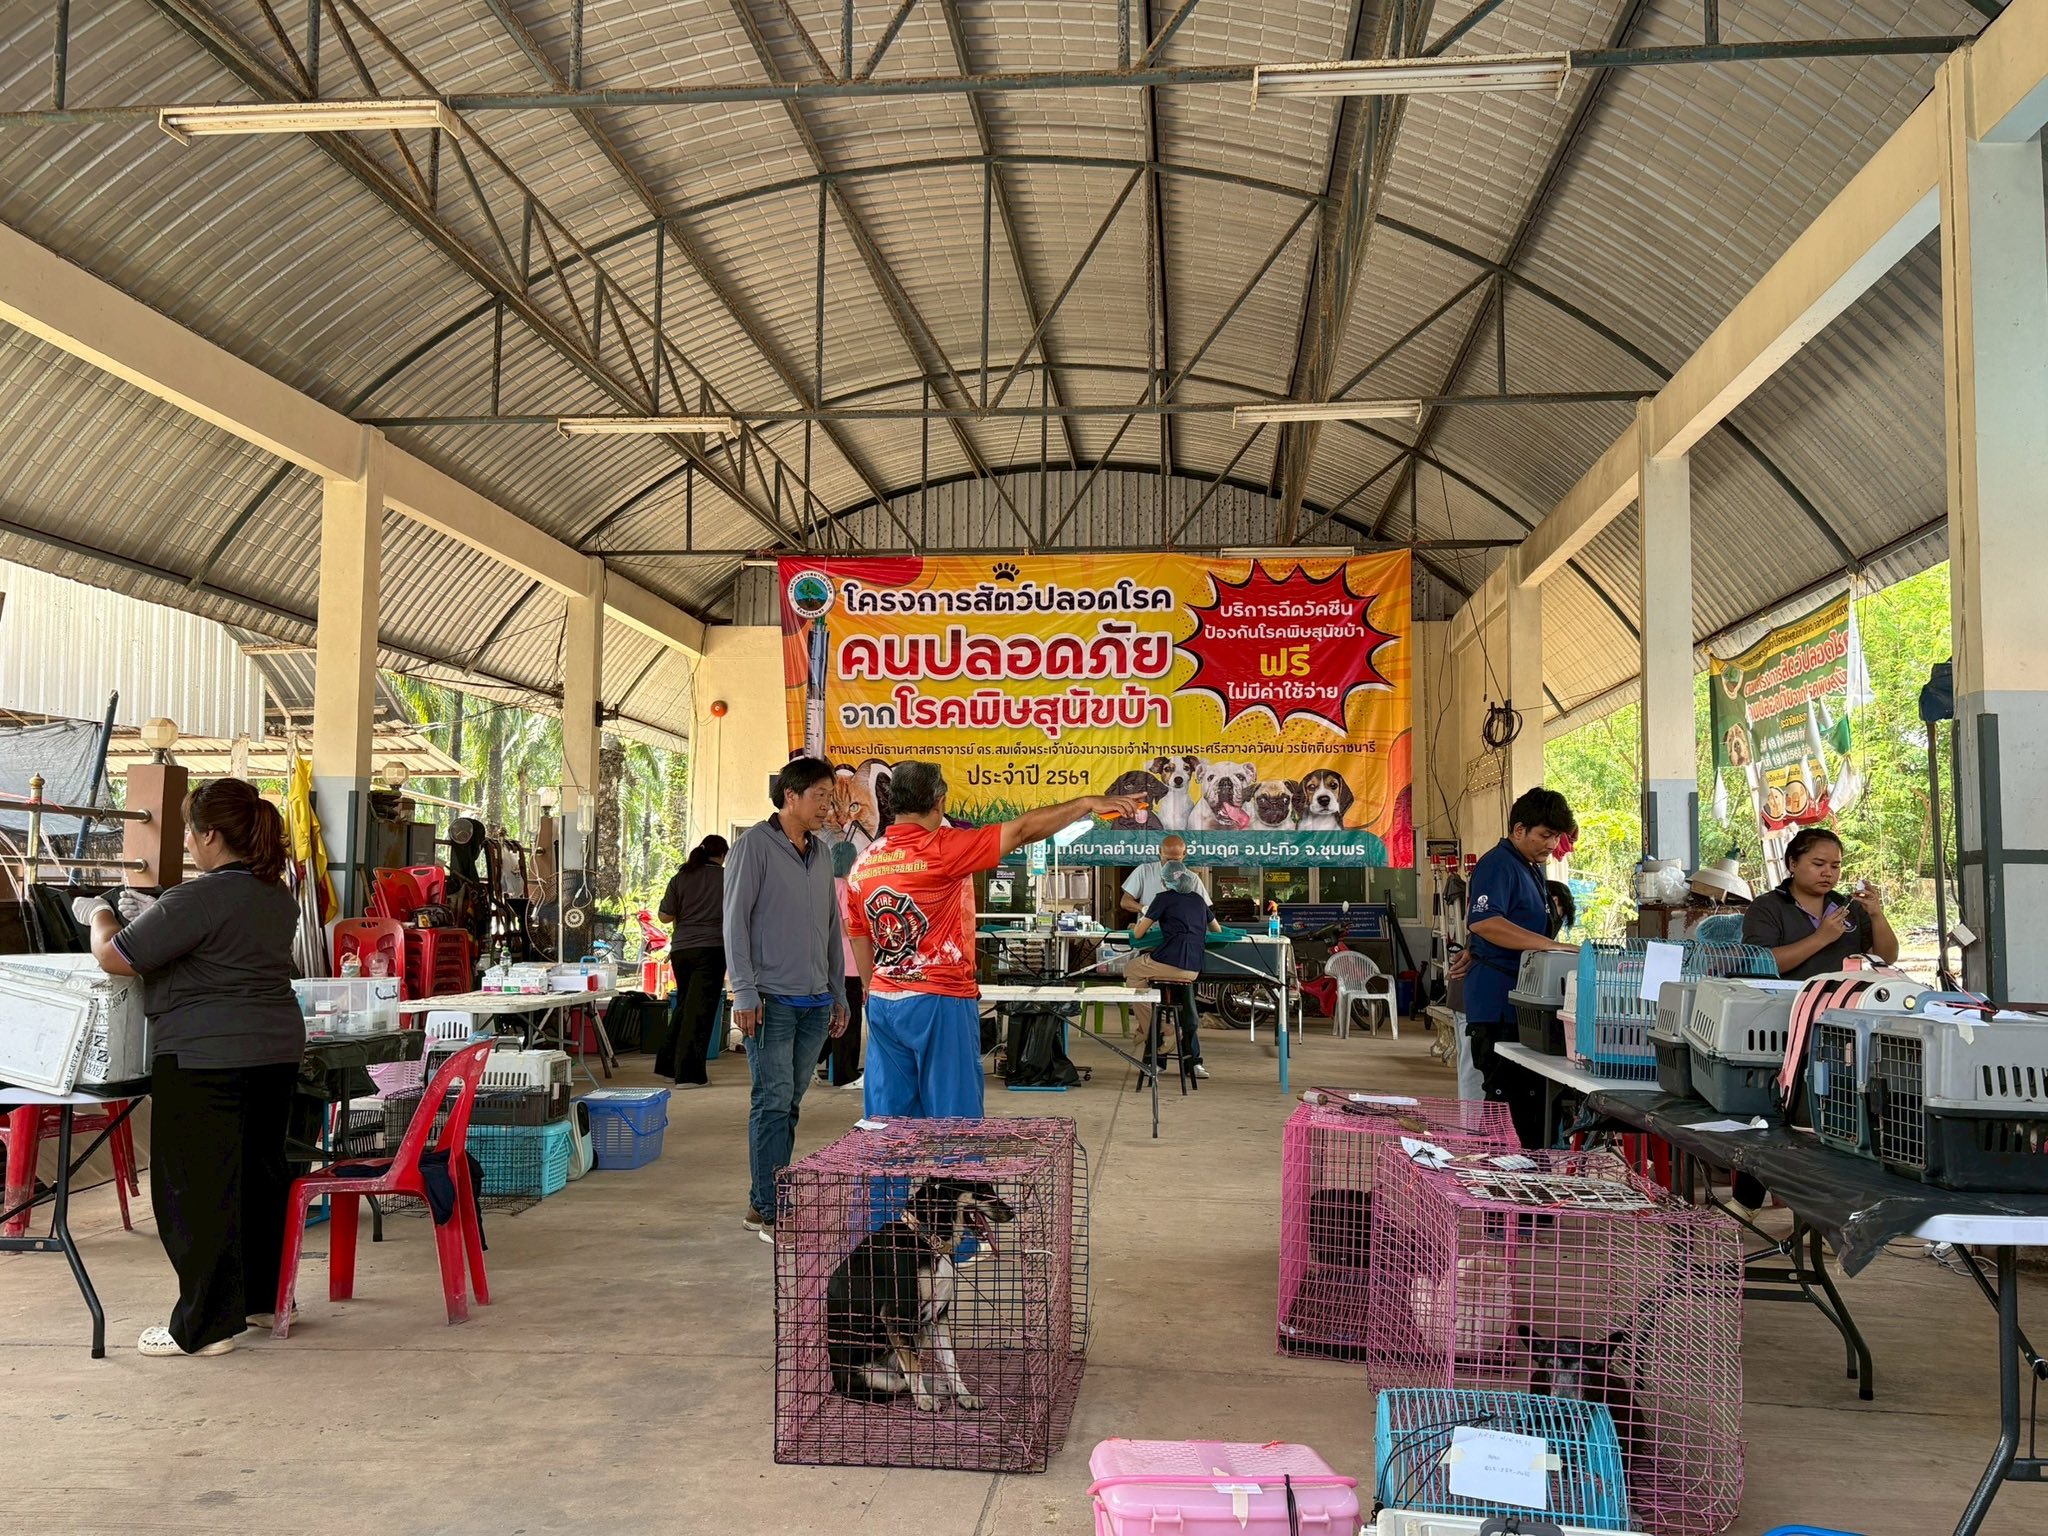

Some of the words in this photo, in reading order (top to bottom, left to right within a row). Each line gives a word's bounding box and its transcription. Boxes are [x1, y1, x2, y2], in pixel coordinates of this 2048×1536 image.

[844, 582, 1172, 612] โครงการสัตว์ปลอดโรค
[1220, 599, 1353, 618] บริการฉีดวัคซีน
[1204, 623, 1365, 642] ป้องกันโรคพิษสุนัขบ้า
[841, 622, 1168, 676] คนปลอดภัย
[1260, 644, 1311, 677] ฟรี
[1227, 682, 1339, 700] ไม่มีค่าใช้จ่าย
[842, 685, 1169, 736] จากโรคพิษสุนัขบ้า
[967, 763, 1039, 786] ประจำปี
[1046, 769, 1089, 786] 2569
[1245, 841, 1299, 858] อ.ปะทิว
[1305, 842, 1365, 860] จ.ชุมพร
[875, 896, 893, 908] FIRE
